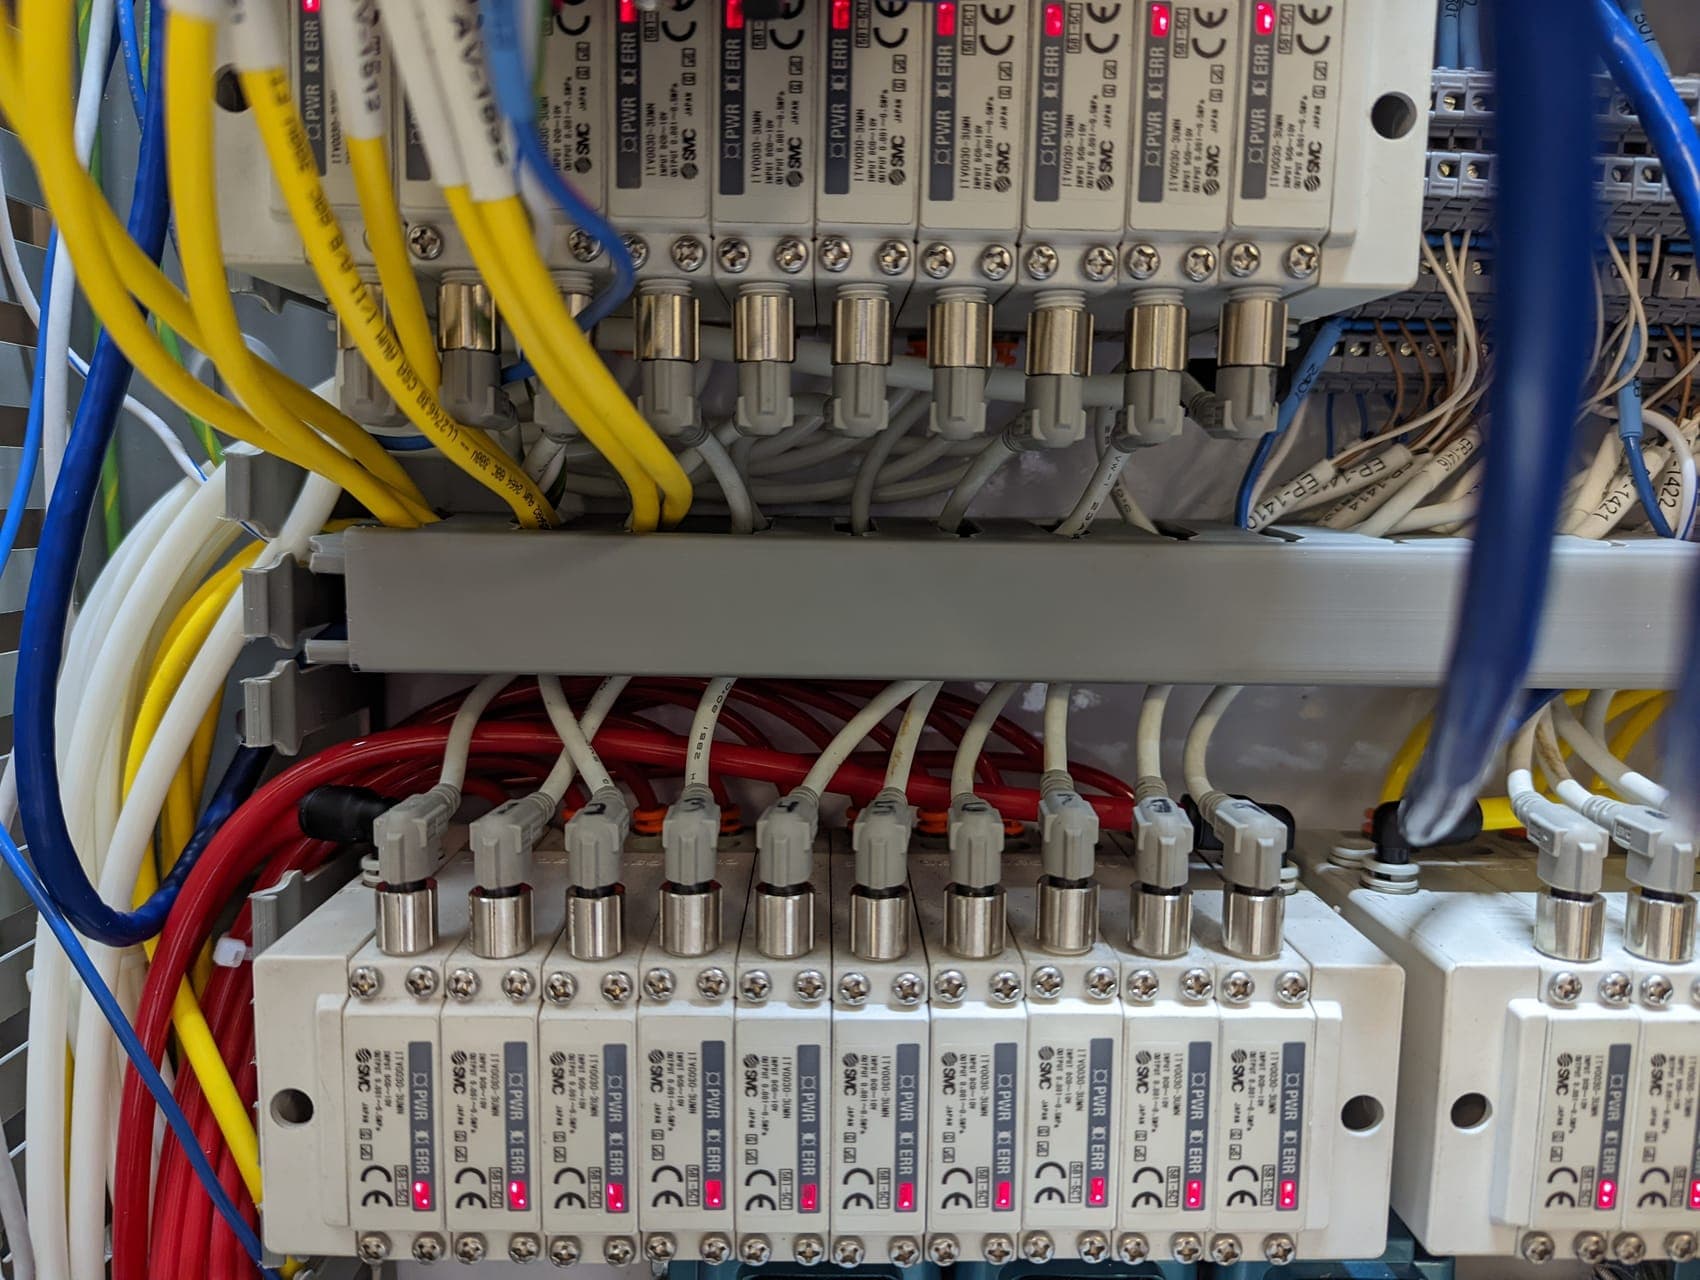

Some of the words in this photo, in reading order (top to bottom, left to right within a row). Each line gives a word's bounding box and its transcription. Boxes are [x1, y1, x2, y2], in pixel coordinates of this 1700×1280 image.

[303, 19, 320, 46] ERR
[556, 0, 591, 36] C
[661, 0, 697, 42] C
[873, 0, 908, 48] CE
[978, 3, 1015, 55] CE
[1084, 2, 1120, 53] CE
[1190, 5, 1228, 59] CE
[1294, 3, 1332, 55] CE
[620, 31, 636, 63] ERR
[725, 37, 741, 70] ERR
[832, 37, 847, 69] ERR
[937, 44, 952, 76] ERR
[1043, 44, 1059, 76] ERR
[1149, 45, 1165, 78] ERR
[1253, 42, 1269, 75] ERR
[304, 83, 322, 120] PWR
[621, 96, 636, 132] PWR
[725, 103, 740, 138] PWR
[831, 102, 846, 138] PWR
[936, 109, 951, 144] PWR
[1042, 109, 1057, 144] PWR
[1146, 110, 1162, 146] PWR
[1249, 107, 1265, 143] PWR
[575, 122, 590, 154] SMC
[681, 128, 696, 160] SMC
[787, 136, 802, 169] SMC
[890, 134, 905, 167] SMC
[996, 142, 1011, 174] SMC
[1098, 140, 1113, 171] SMC
[1205, 145, 1220, 177] SMC
[1306, 141, 1322, 173] SMC
[356, 1064, 370, 1092] SMC
[451, 1067, 466, 1094] SMC
[550, 1067, 565, 1094] SMC
[649, 1065, 663, 1092] SMC
[743, 1070, 757, 1097] SMC
[843, 1069, 856, 1095] SMC
[942, 1068, 955, 1095] SMC
[1038, 1062, 1051, 1089] SMC
[1135, 1067, 1149, 1093] SMC
[1230, 1064, 1244, 1092] SMC
[1555, 1068, 1570, 1095] SMC
[1648, 1069, 1664, 1096] SMC
[413, 1089, 427, 1120] PWR
[508, 1090, 523, 1120] PWR
[607, 1092, 622, 1122] PWR
[705, 1089, 719, 1118] PWR
[800, 1092, 815, 1122] PWR
[899, 1092, 913, 1121] PWR
[997, 1091, 1010, 1120] PWR
[1092, 1086, 1106, 1116] PWR
[1189, 1090, 1204, 1119] PWR
[1284, 1090, 1298, 1120] PWR
[1606, 1091, 1621, 1120] PWR
[415, 1147, 430, 1174] ERR
[510, 1148, 525, 1174] ERR
[609, 1149, 624, 1176] ERR
[706, 1146, 721, 1173] ERR
[801, 1150, 815, 1176] ERR
[898, 1149, 913, 1175] ERR
[996, 1148, 1010, 1174] ERR
[1090, 1144, 1105, 1170] ERR
[1188, 1147, 1202, 1174] ERR
[1282, 1147, 1296, 1174] ERR
[1601, 1147, 1616, 1173] ERR
[359, 1164, 393, 1207] CE
[453, 1167, 487, 1209] CE
[552, 1166, 586, 1209] CE
[650, 1165, 684, 1207] CE
[743, 1169, 777, 1211] CE
[841, 1168, 874, 1209] CE
[941, 1167, 973, 1209] CE
[1034, 1161, 1067, 1203] CE
[1131, 1166, 1164, 1208] CE
[1226, 1164, 1259, 1206] CE
[1544, 1166, 1579, 1208] CE
[1636, 1166, 1671, 1208] CE
